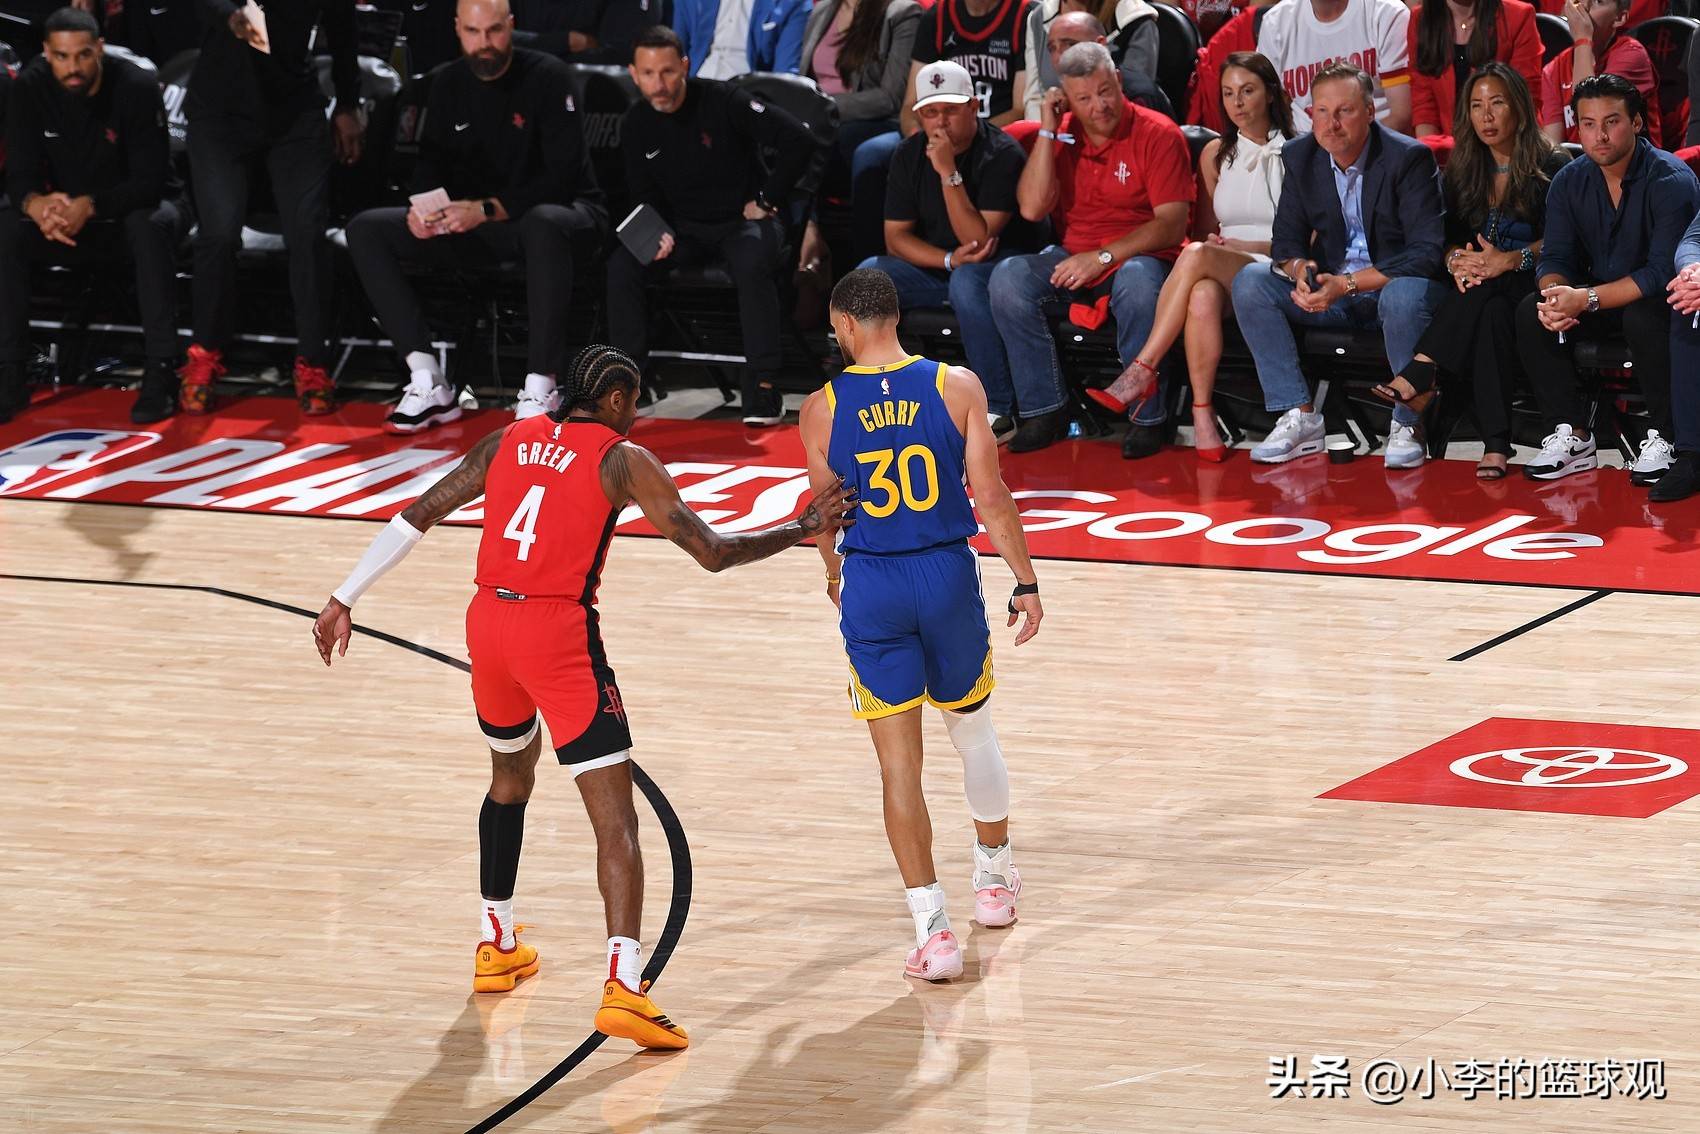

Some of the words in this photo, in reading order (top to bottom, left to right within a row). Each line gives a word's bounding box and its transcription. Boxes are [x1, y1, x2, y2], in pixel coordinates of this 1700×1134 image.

[857, 400, 921, 433] CURRY
[517, 442, 577, 474] GREEN
[854, 443, 940, 518] 30
[503, 484, 546, 562] 4
[968, 489, 1604, 565] Google
